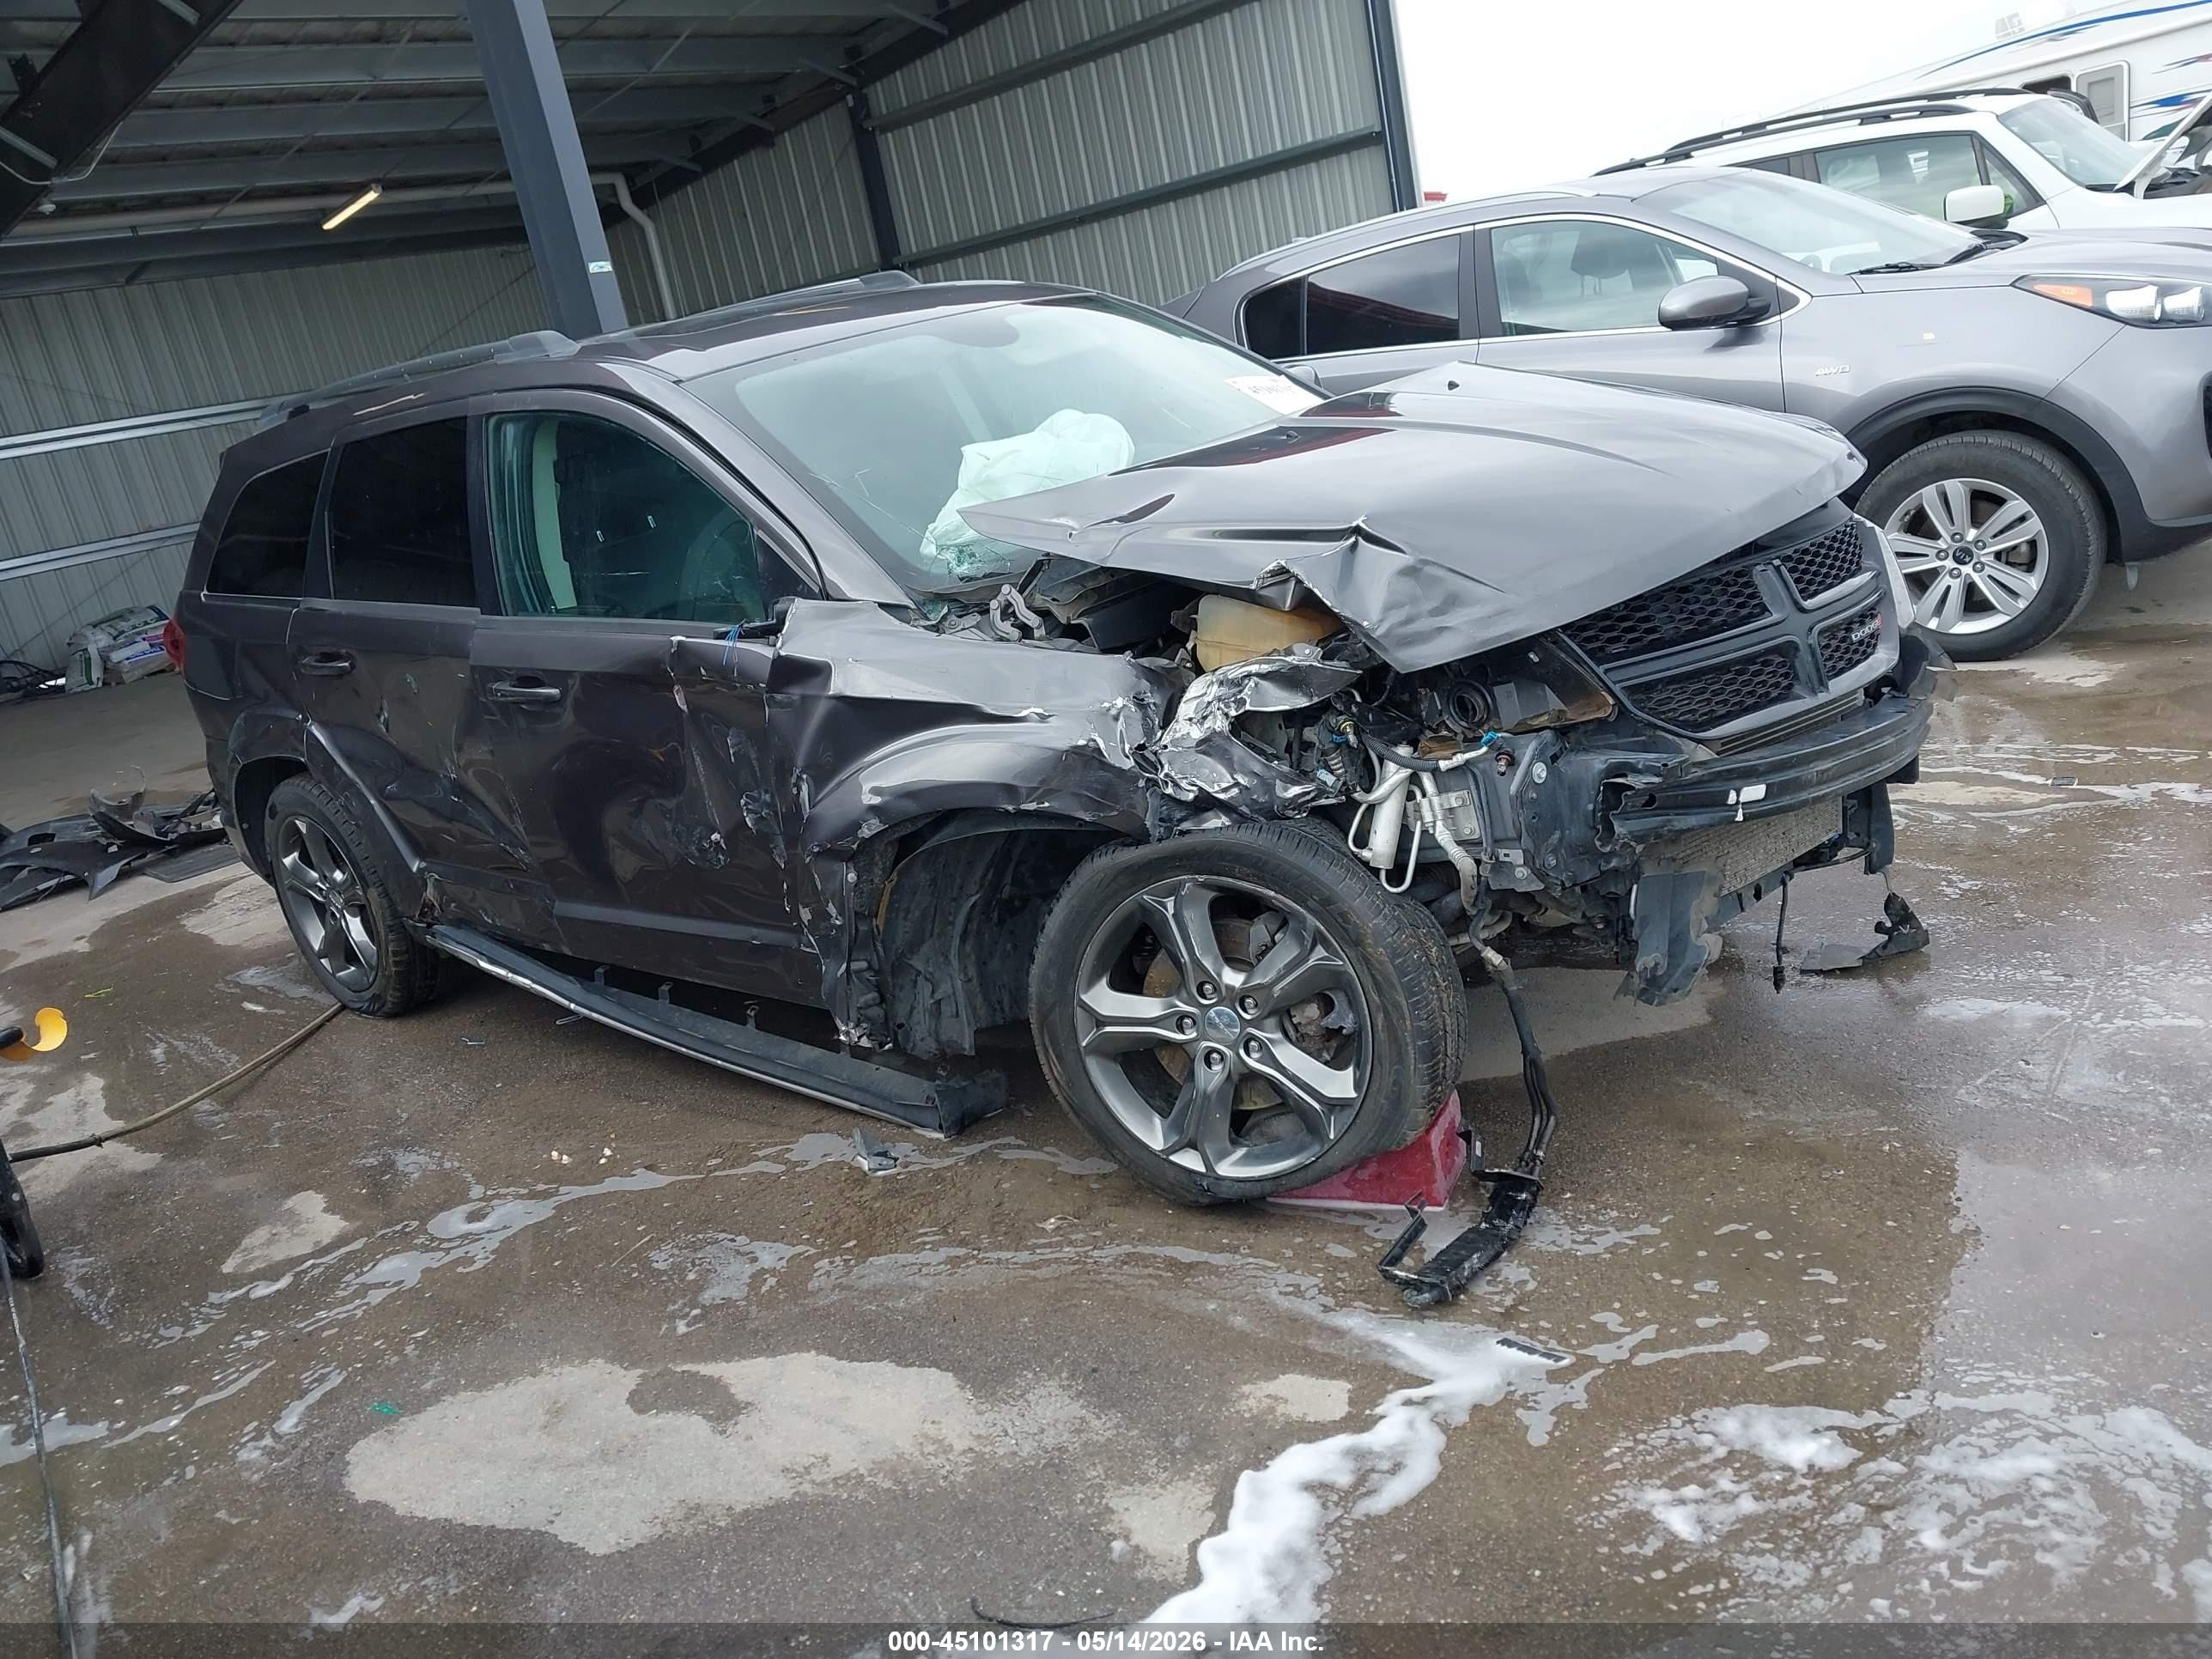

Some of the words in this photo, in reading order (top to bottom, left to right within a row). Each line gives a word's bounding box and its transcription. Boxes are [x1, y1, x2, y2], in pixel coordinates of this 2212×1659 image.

[1815, 365, 1851, 377] AWD
[1955, 548, 1972, 563] KIA
[1851, 617, 1882, 641] DODGE
